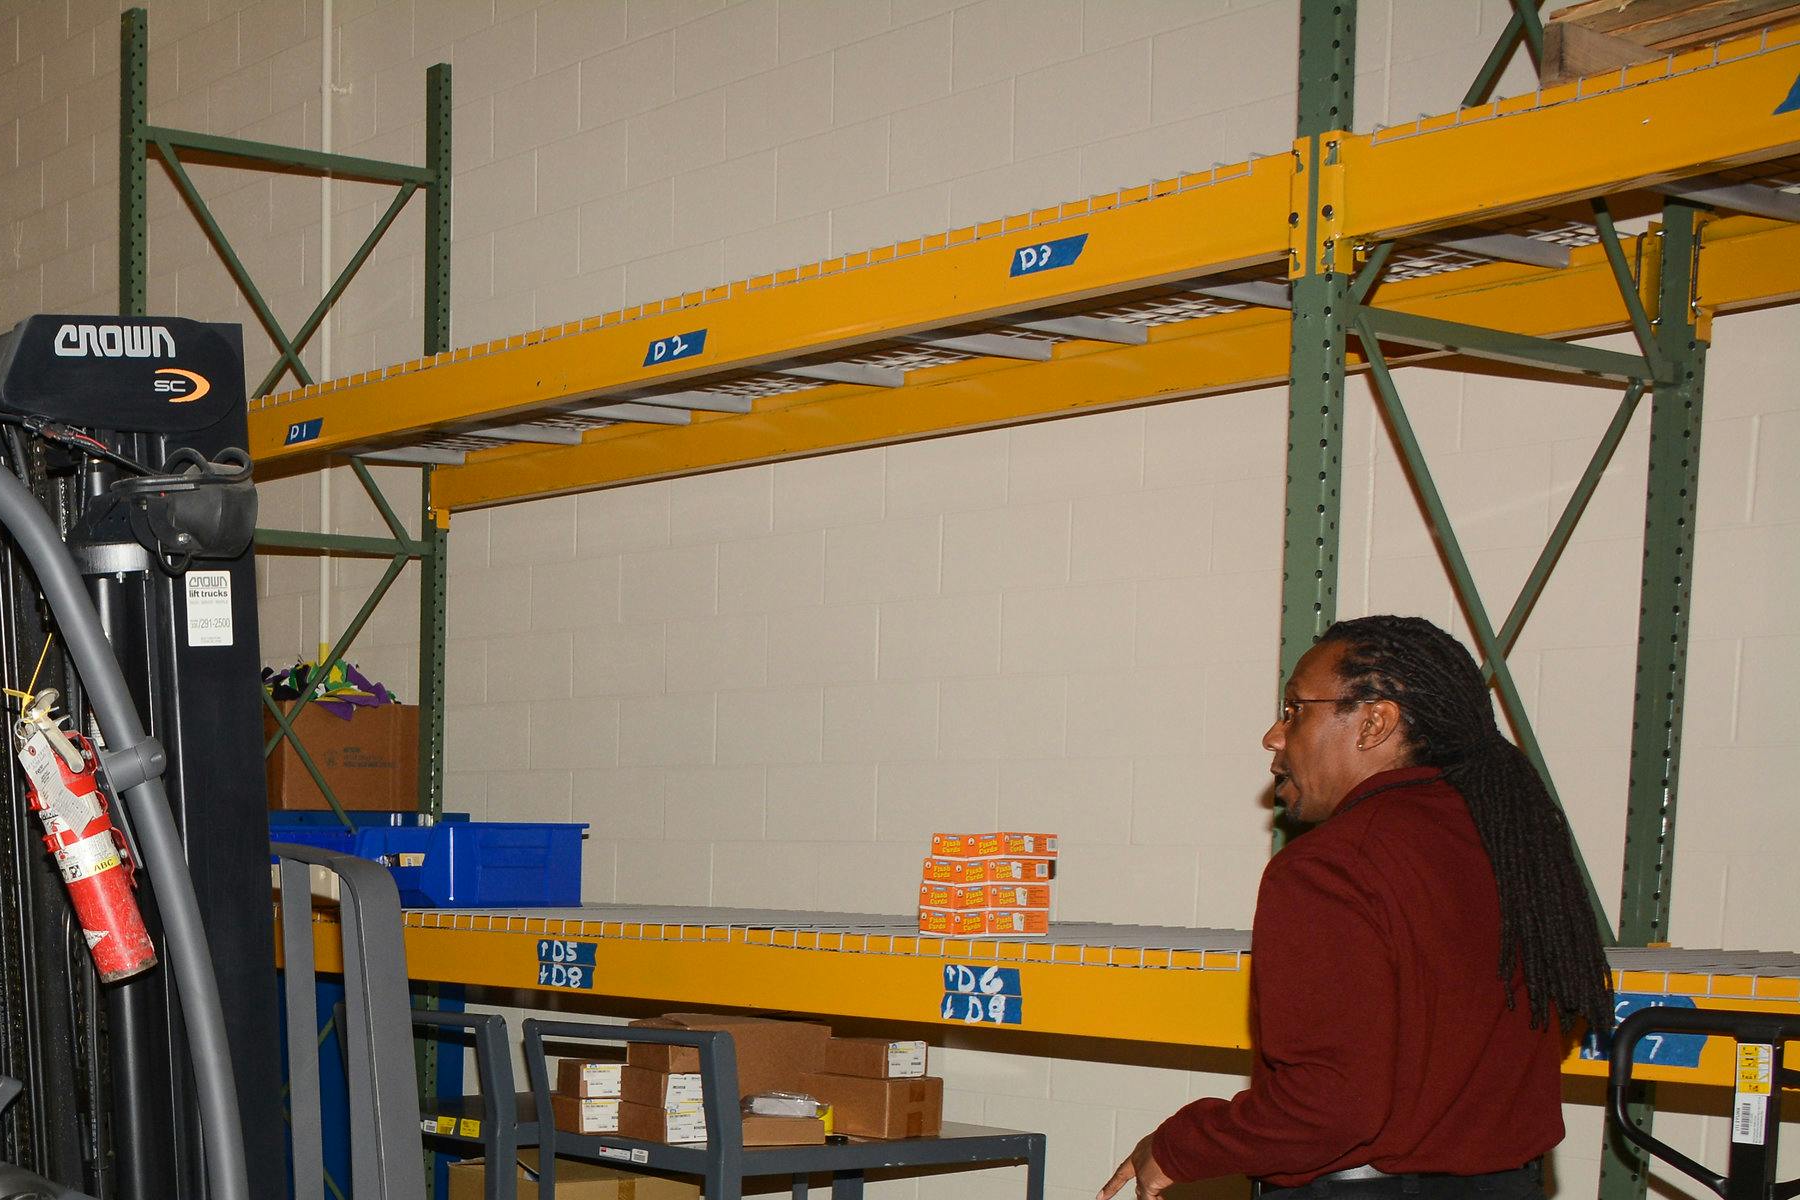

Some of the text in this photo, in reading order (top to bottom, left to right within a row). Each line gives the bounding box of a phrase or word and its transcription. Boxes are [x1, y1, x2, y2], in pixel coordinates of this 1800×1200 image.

[1019, 245, 1052, 271] D3
[54, 324, 176, 358] CROWN
[653, 335, 689, 361] D2
[154, 379, 187, 393] SC
[290, 423, 307, 440] D1
[189, 576, 227, 587] CROWN
[189, 589, 228, 598] lift trucks
[979, 840, 998, 849] Flash
[979, 846, 999, 855] Cards
[93, 858, 113, 872] ABC
[966, 867, 983, 876] Flash
[965, 897, 984, 905] Cards
[966, 891, 983, 899] Flash
[963, 916, 981, 925] Flash
[963, 923, 981, 931] Cards
[552, 940, 578, 962] D5
[551, 964, 583, 988] D8
[957, 965, 1004, 994] D6
[965, 994, 1006, 1024] D9
